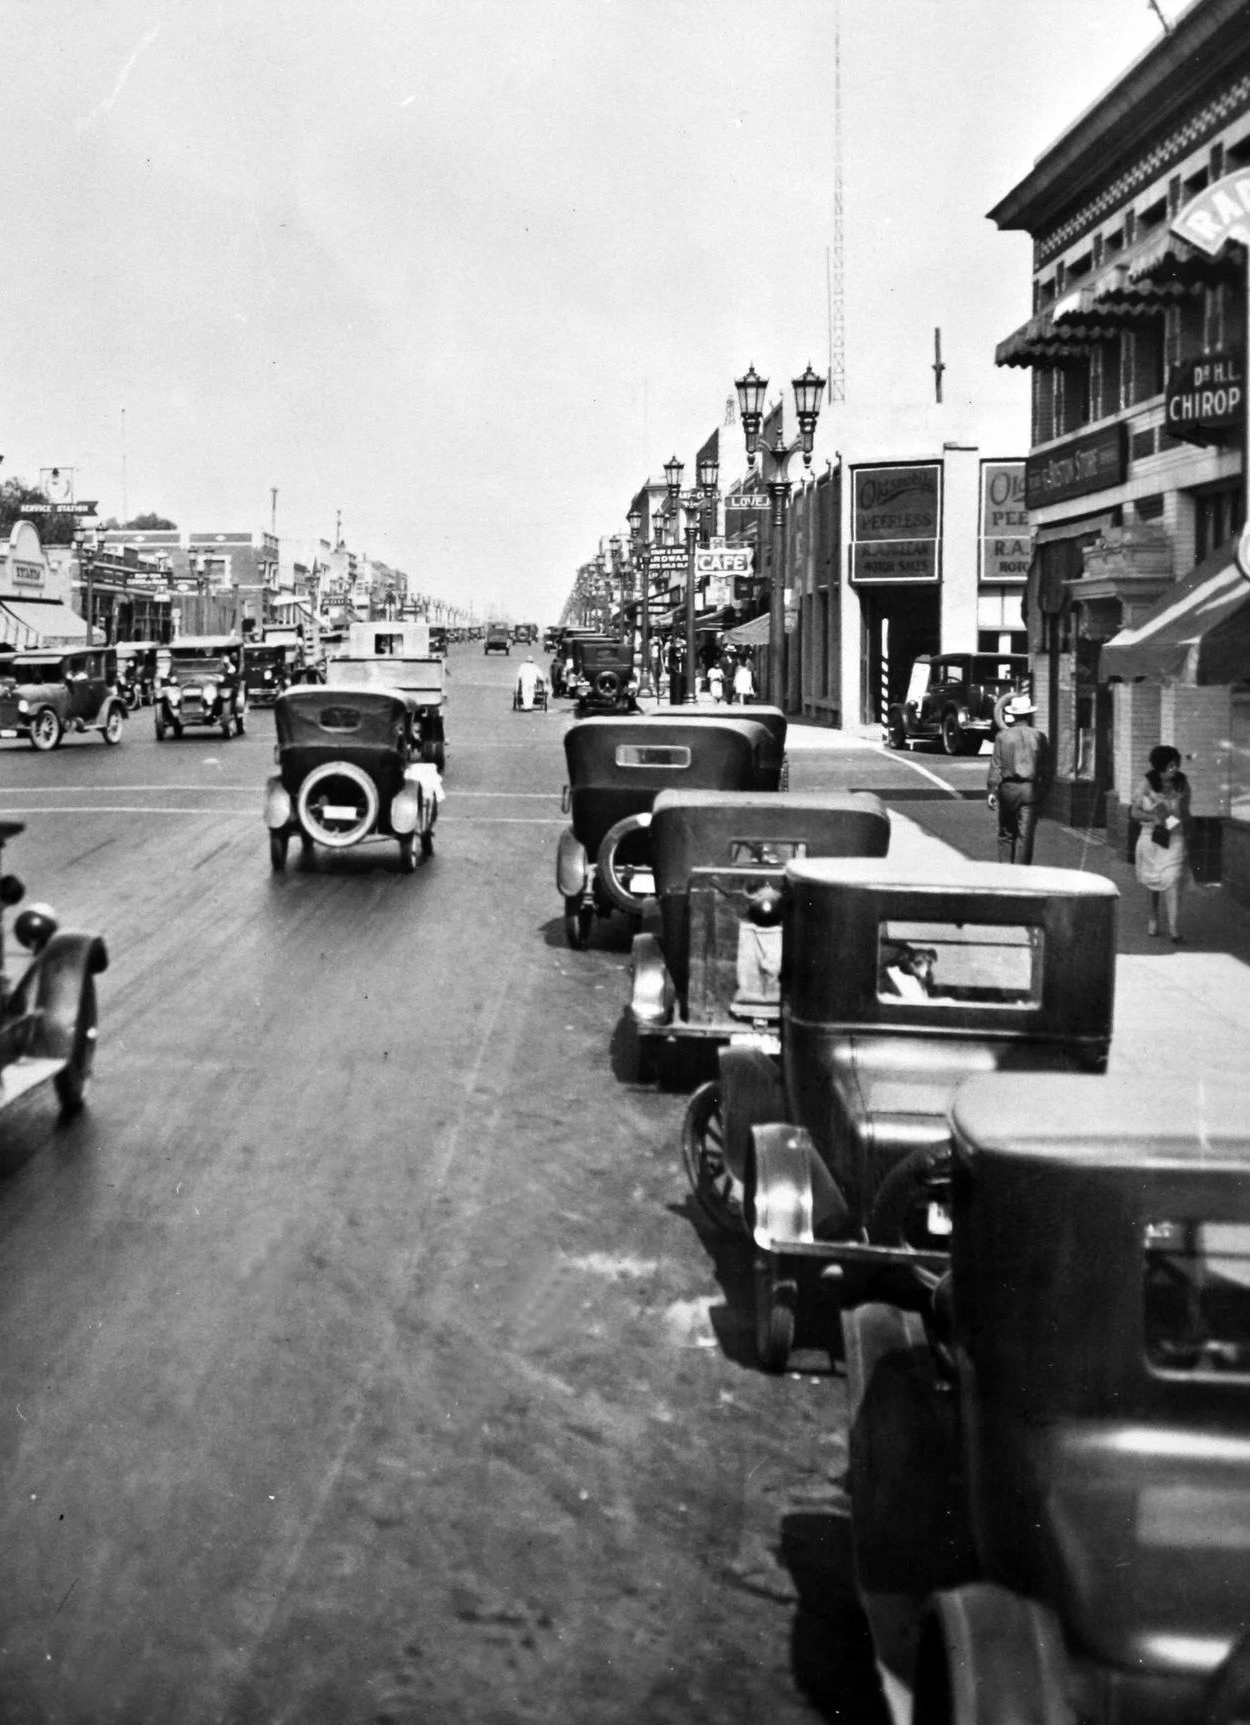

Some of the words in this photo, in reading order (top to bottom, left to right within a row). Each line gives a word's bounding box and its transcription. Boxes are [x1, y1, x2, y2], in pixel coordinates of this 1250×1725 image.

[1186, 179, 1250, 240] RA
[1170, 387, 1241, 420] CHIROP
[21, 504, 51, 512] SERVICE
[861, 513, 932, 531] PEERLESS
[699, 555, 745, 570] CAFE
